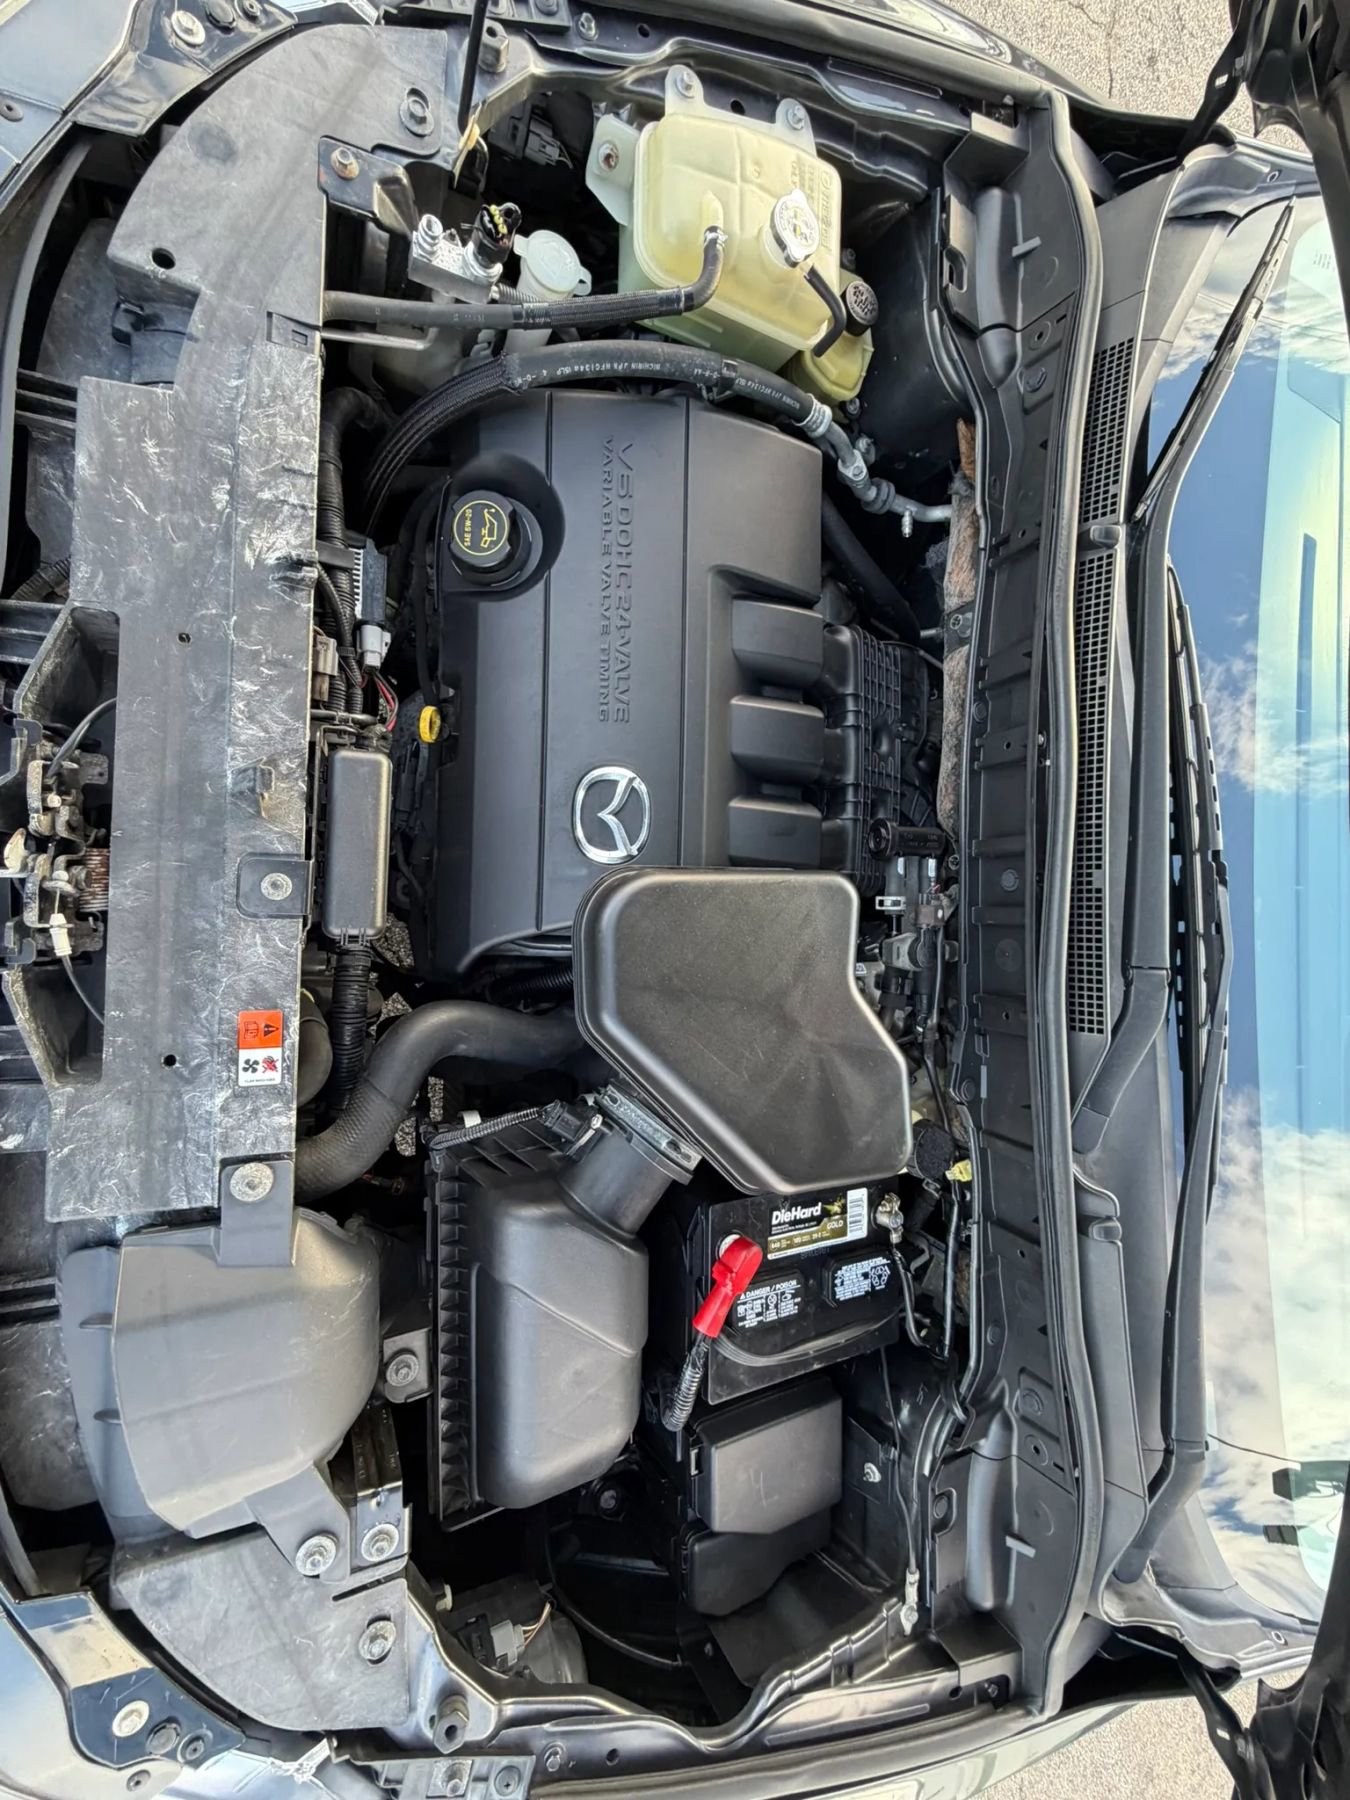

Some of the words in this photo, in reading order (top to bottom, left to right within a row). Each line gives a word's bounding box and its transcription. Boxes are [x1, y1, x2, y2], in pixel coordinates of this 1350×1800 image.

[600, 435, 614, 557] VARIABLE
[600, 561, 613, 636] VALVE
[599, 640, 612, 723] TIMING
[771, 1201, 822, 1226] DieHard
[826, 1220, 844, 1230] GOLD
[745, 1286, 770, 1298] DANGER
[775, 1279, 797, 1291] POISON
